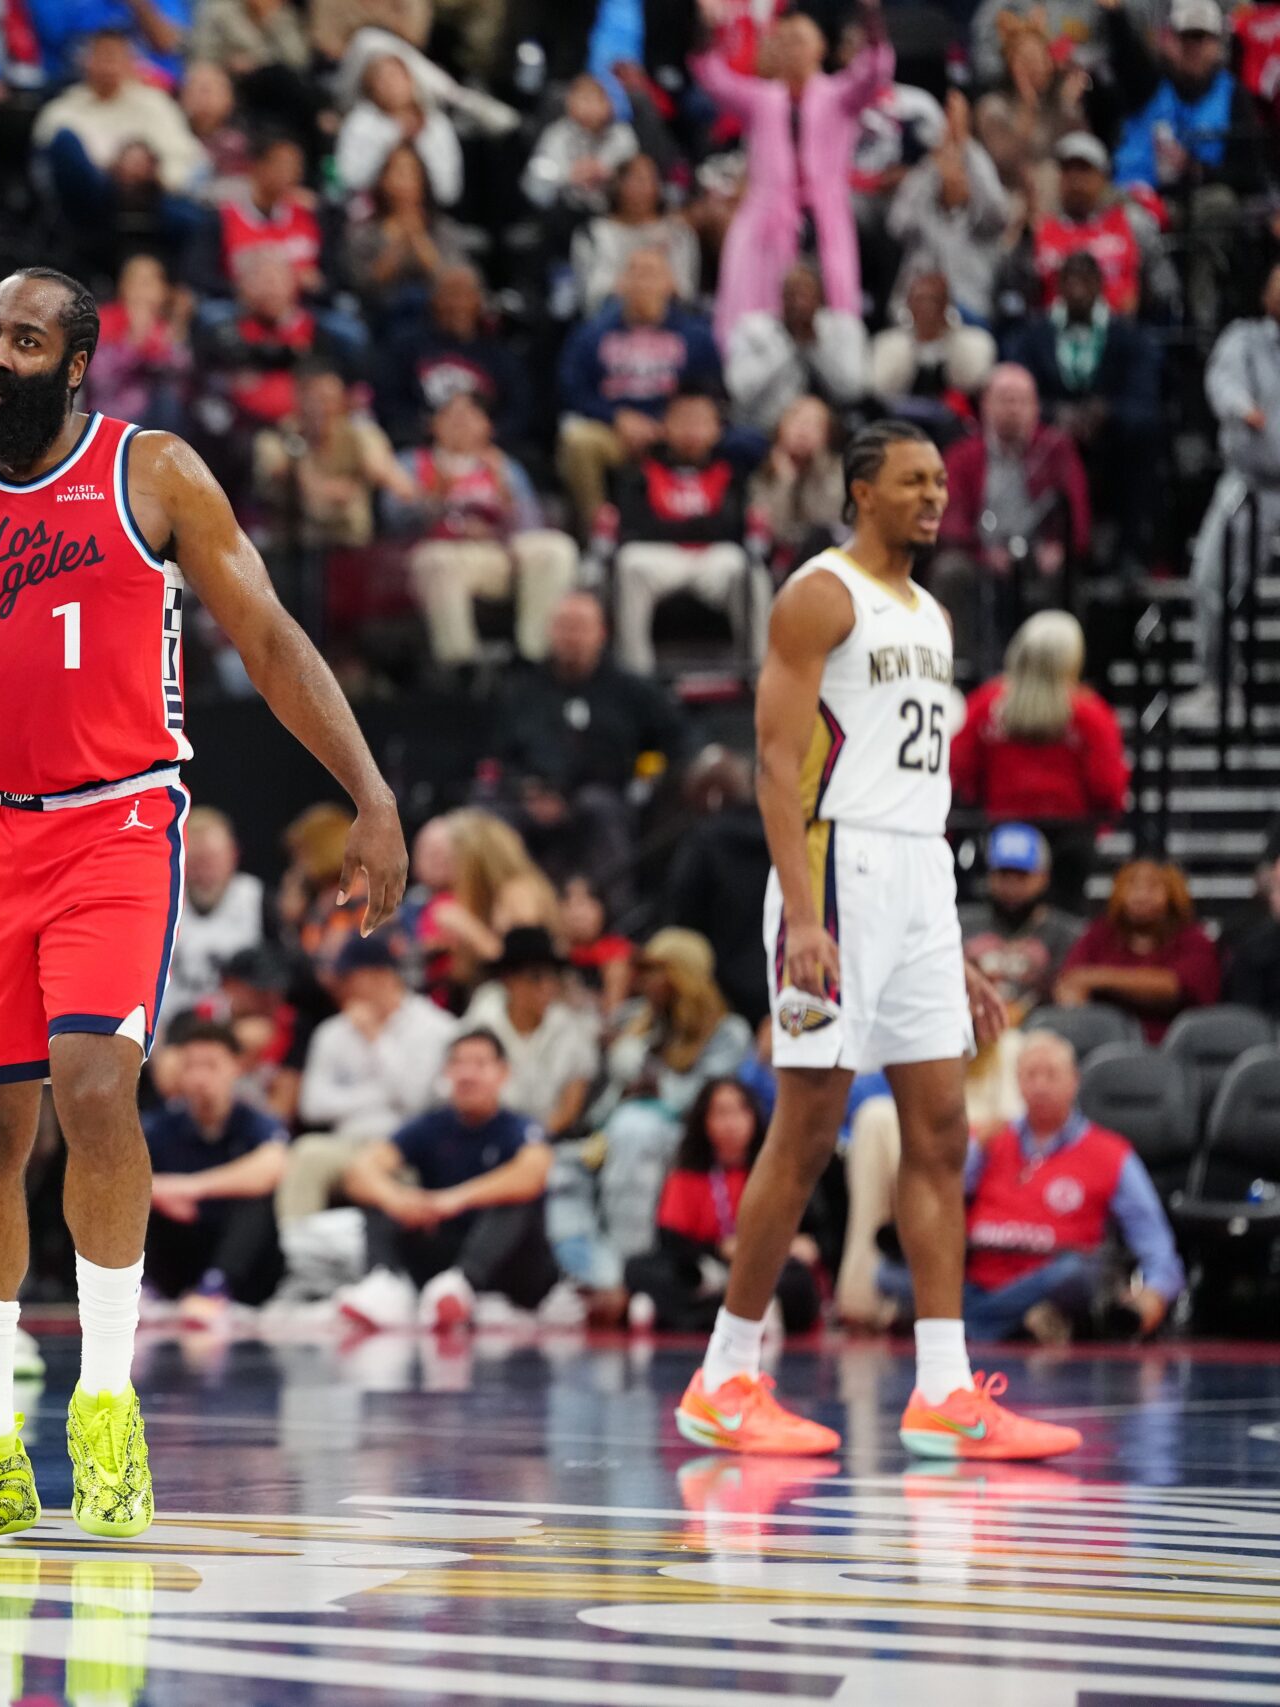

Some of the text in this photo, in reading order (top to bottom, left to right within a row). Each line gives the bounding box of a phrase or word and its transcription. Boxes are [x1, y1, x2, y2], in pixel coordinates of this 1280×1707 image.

[56, 492, 105, 503] RWANDA
[67, 484, 95, 493] VISIT
[52, 601, 81, 669] 1
[868, 645, 910, 687] NEW
[897, 698, 944, 774] 25
